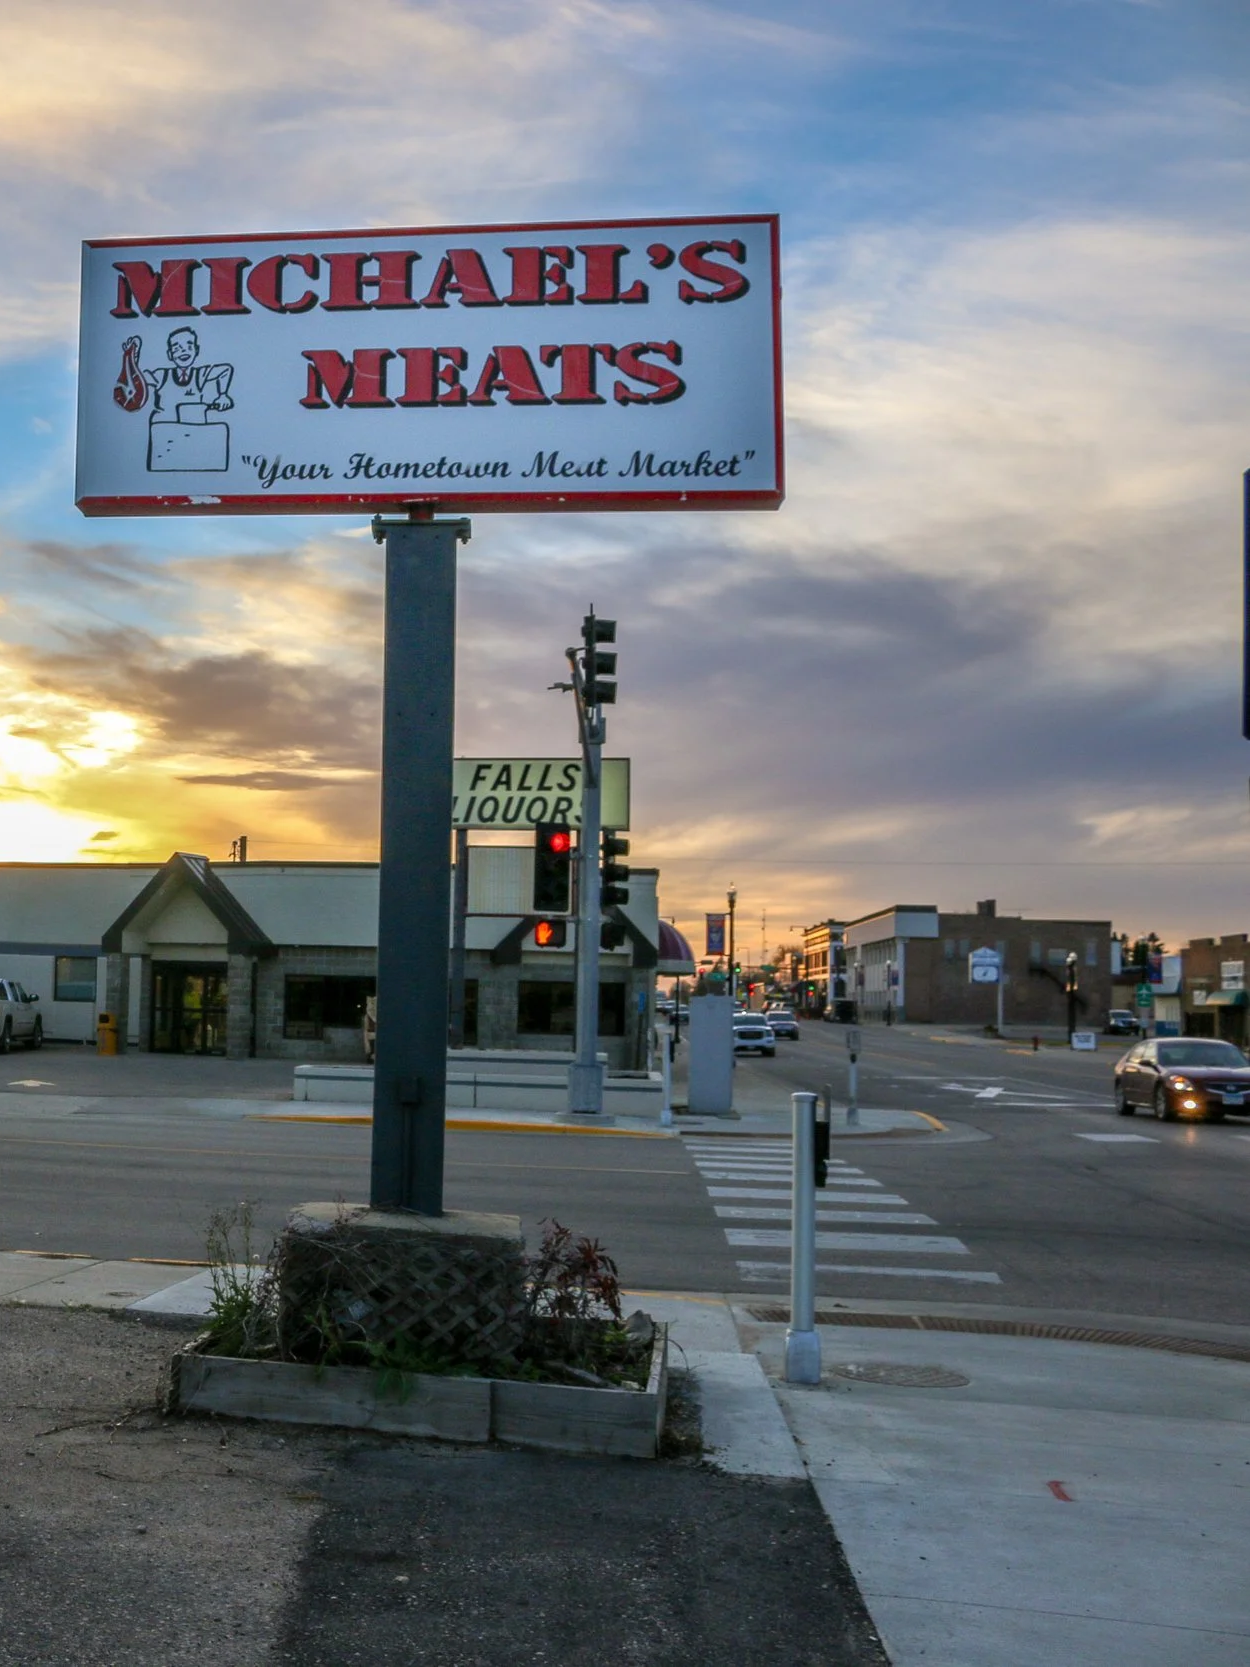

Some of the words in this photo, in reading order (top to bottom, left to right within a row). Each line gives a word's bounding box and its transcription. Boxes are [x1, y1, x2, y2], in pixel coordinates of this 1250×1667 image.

[109, 238, 751, 319] MICHAEL'S
[298, 340, 687, 409] MEATS
[241, 453, 333, 489] "Your
[343, 452, 512, 479] Hometown
[521, 450, 609, 478] Meat
[618, 449, 756, 478] Market"
[469, 763, 582, 792] FALLS
[452, 796, 582, 824] IQUOR
